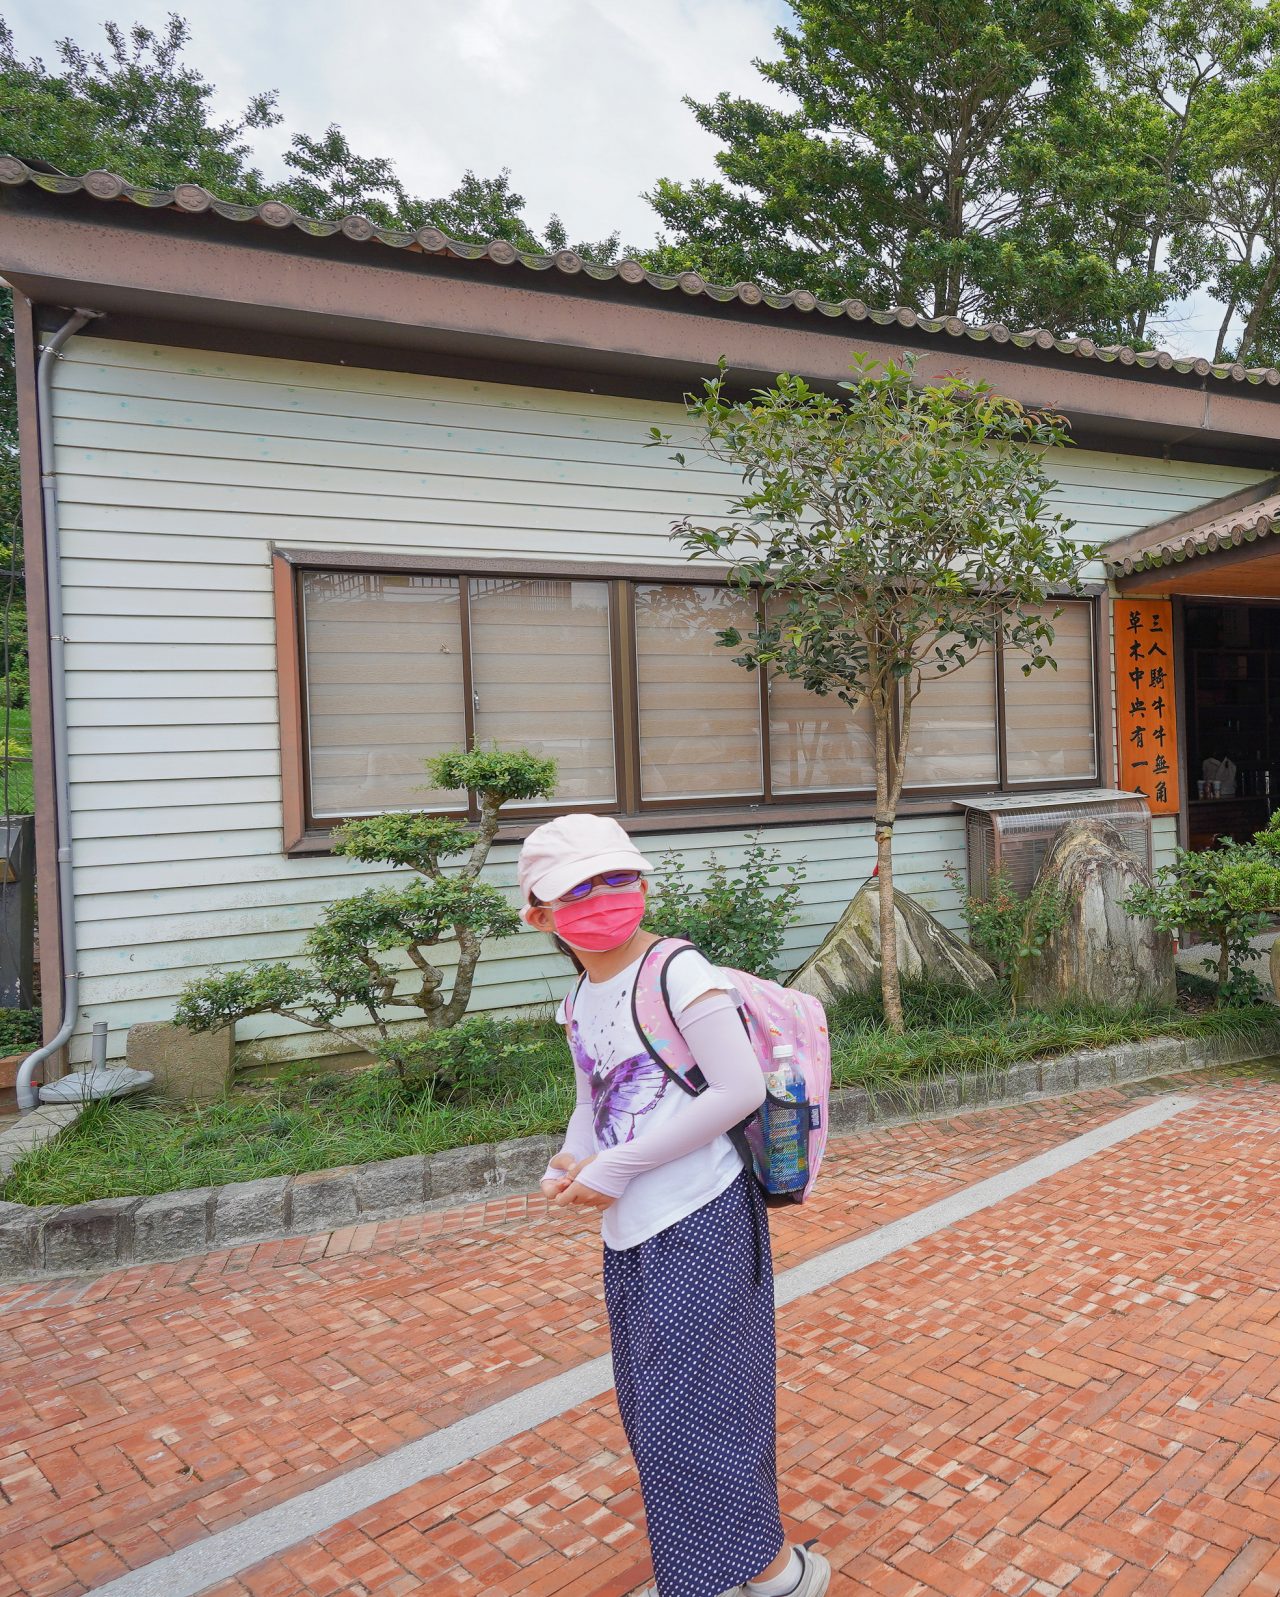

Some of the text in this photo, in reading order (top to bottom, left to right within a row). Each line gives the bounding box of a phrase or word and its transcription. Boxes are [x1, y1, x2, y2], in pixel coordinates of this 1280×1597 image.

[1148, 615, 1170, 803] 三人騎牛牛無角
